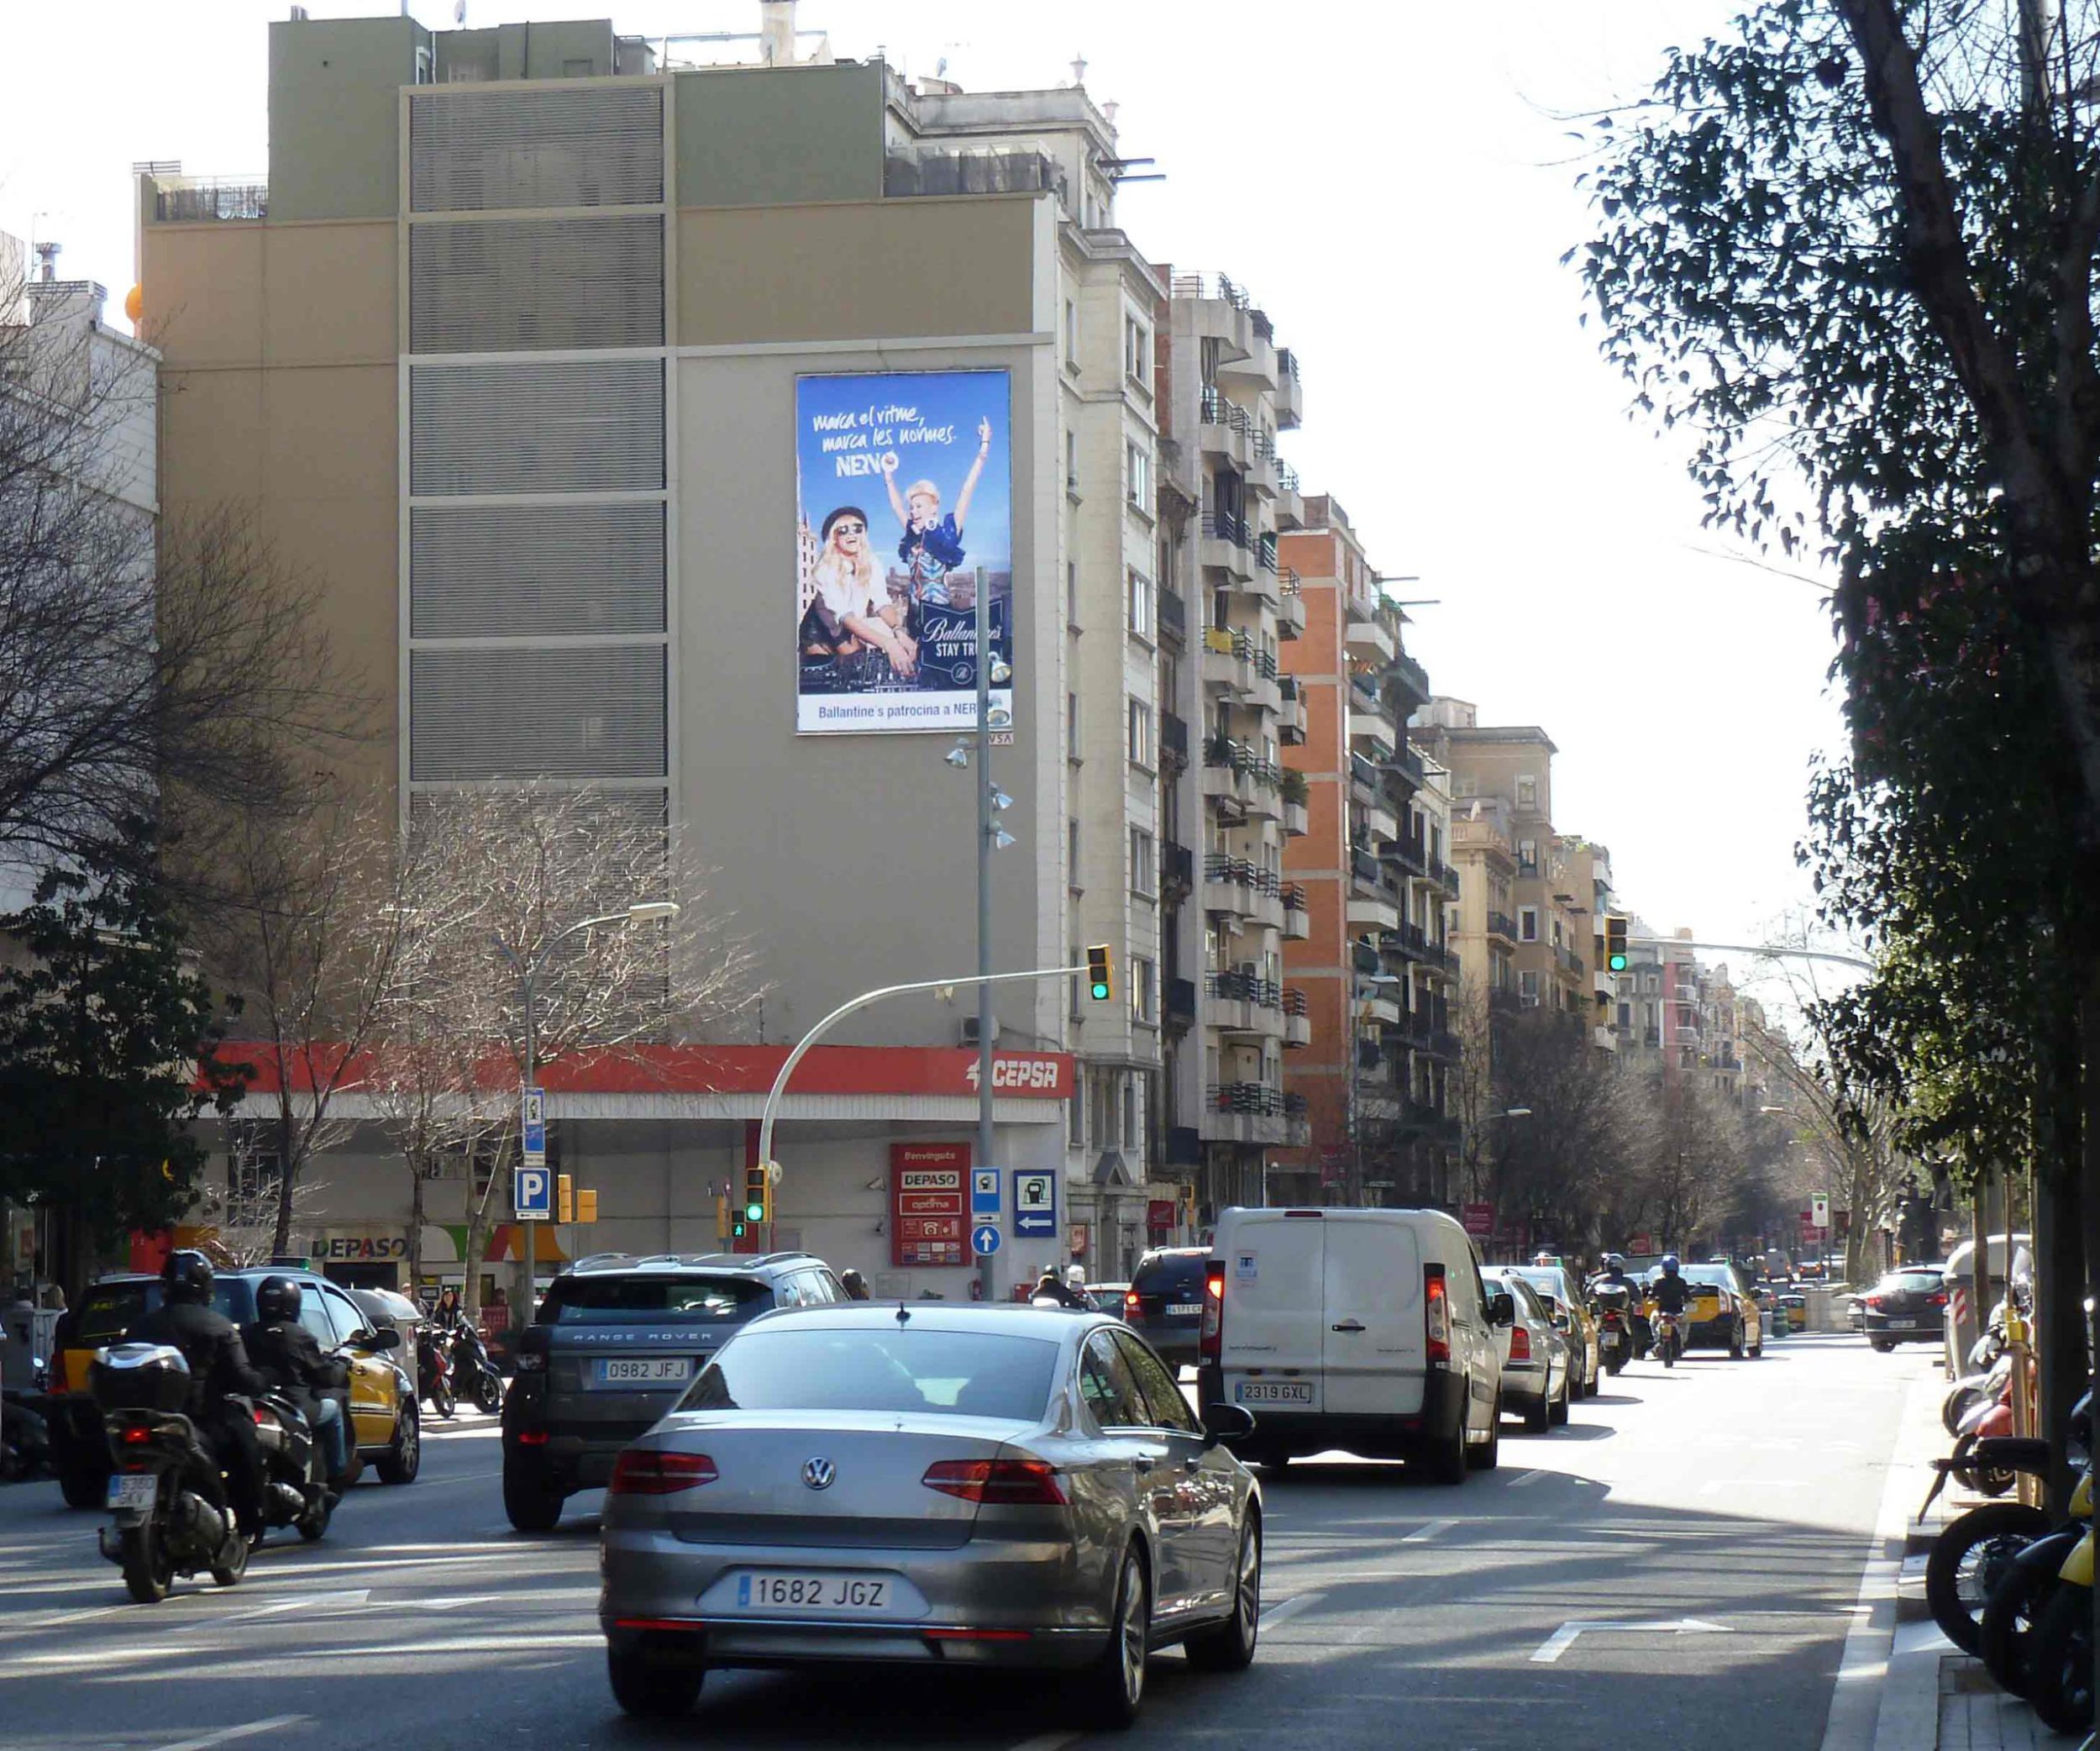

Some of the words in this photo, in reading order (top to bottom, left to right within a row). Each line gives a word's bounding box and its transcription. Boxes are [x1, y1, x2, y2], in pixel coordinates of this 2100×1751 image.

[813, 411, 857, 432] marca
[859, 405, 874, 427] el
[822, 434, 868, 453] marca
[873, 427, 894, 446] les
[835, 450, 900, 478] NERVO
[936, 642, 959, 657] STAY
[962, 642, 979, 657] TR
[887, 704, 940, 719] patrocina
[943, 706, 950, 715] a
[953, 702, 978, 715] NER
[992, 1060, 1058, 1088] CEPSA
[522, 1173, 543, 1207] P
[905, 1174, 956, 1186] DEPASO
[312, 1237, 407, 1259] DEPASO
[609, 1363, 649, 1378] 0982
[654, 1362, 685, 1378] JFJ
[1245, 1386, 1278, 1399] 2319
[1282, 1386, 1309, 1399] GXL
[759, 1579, 822, 1605] 1682
[832, 1580, 885, 1607] JGZ
